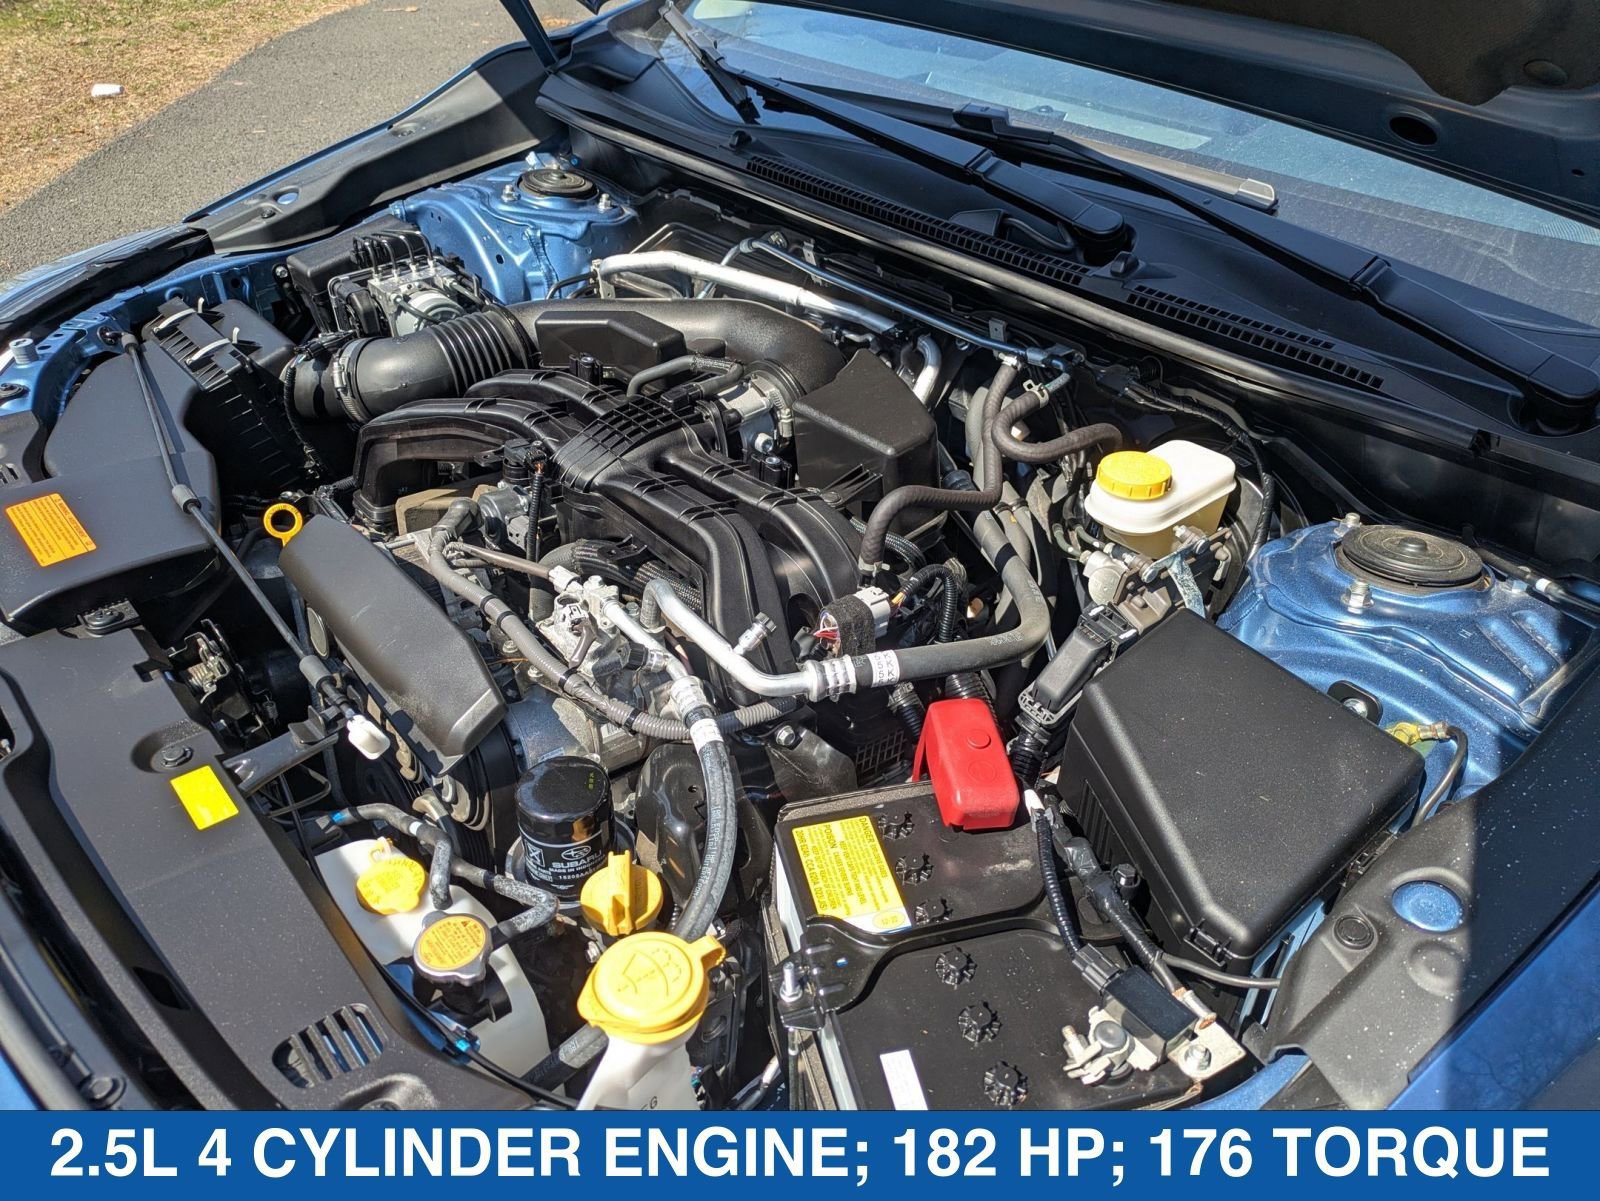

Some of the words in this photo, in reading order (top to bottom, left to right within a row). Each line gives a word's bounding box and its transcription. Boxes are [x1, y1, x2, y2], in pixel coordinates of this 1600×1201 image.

[823, 824, 837, 848] POISON
[859, 817, 875, 842] DANGER
[552, 850, 601, 868] SUBARU
